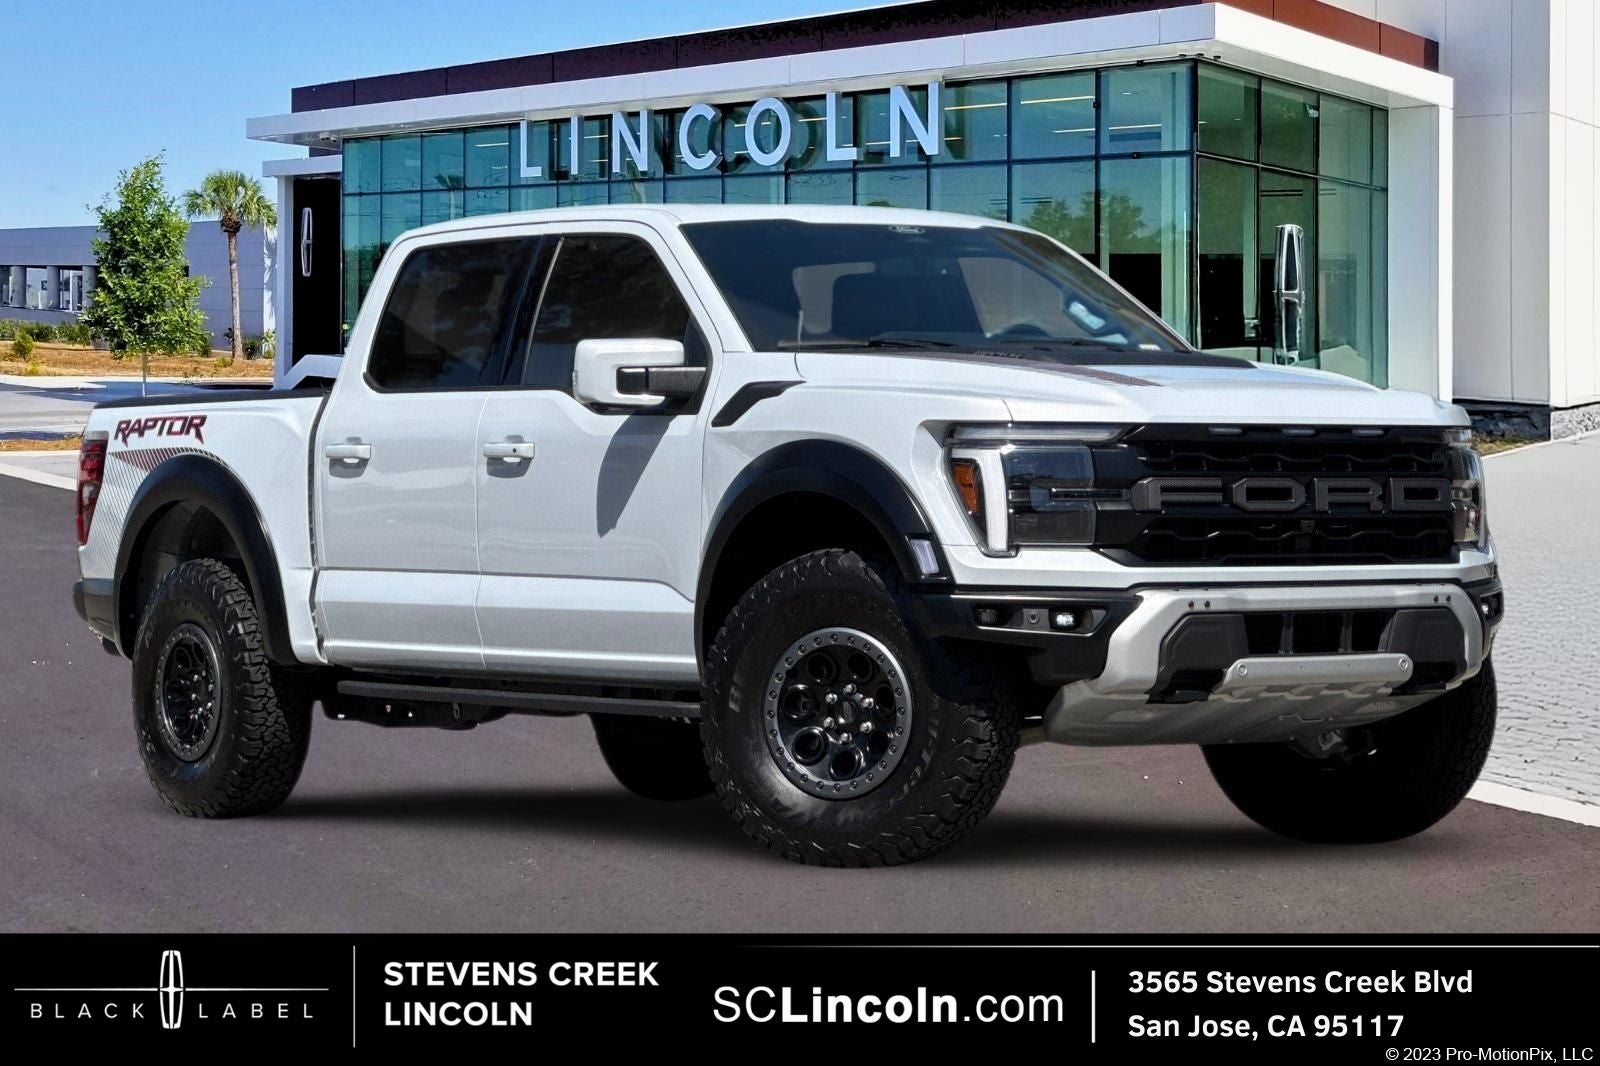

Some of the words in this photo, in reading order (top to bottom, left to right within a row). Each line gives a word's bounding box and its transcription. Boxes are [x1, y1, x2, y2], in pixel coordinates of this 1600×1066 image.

[519, 81, 944, 178] LINCOLN
[113, 414, 208, 448] RAPTOR
[1131, 476, 1453, 513] FORD
